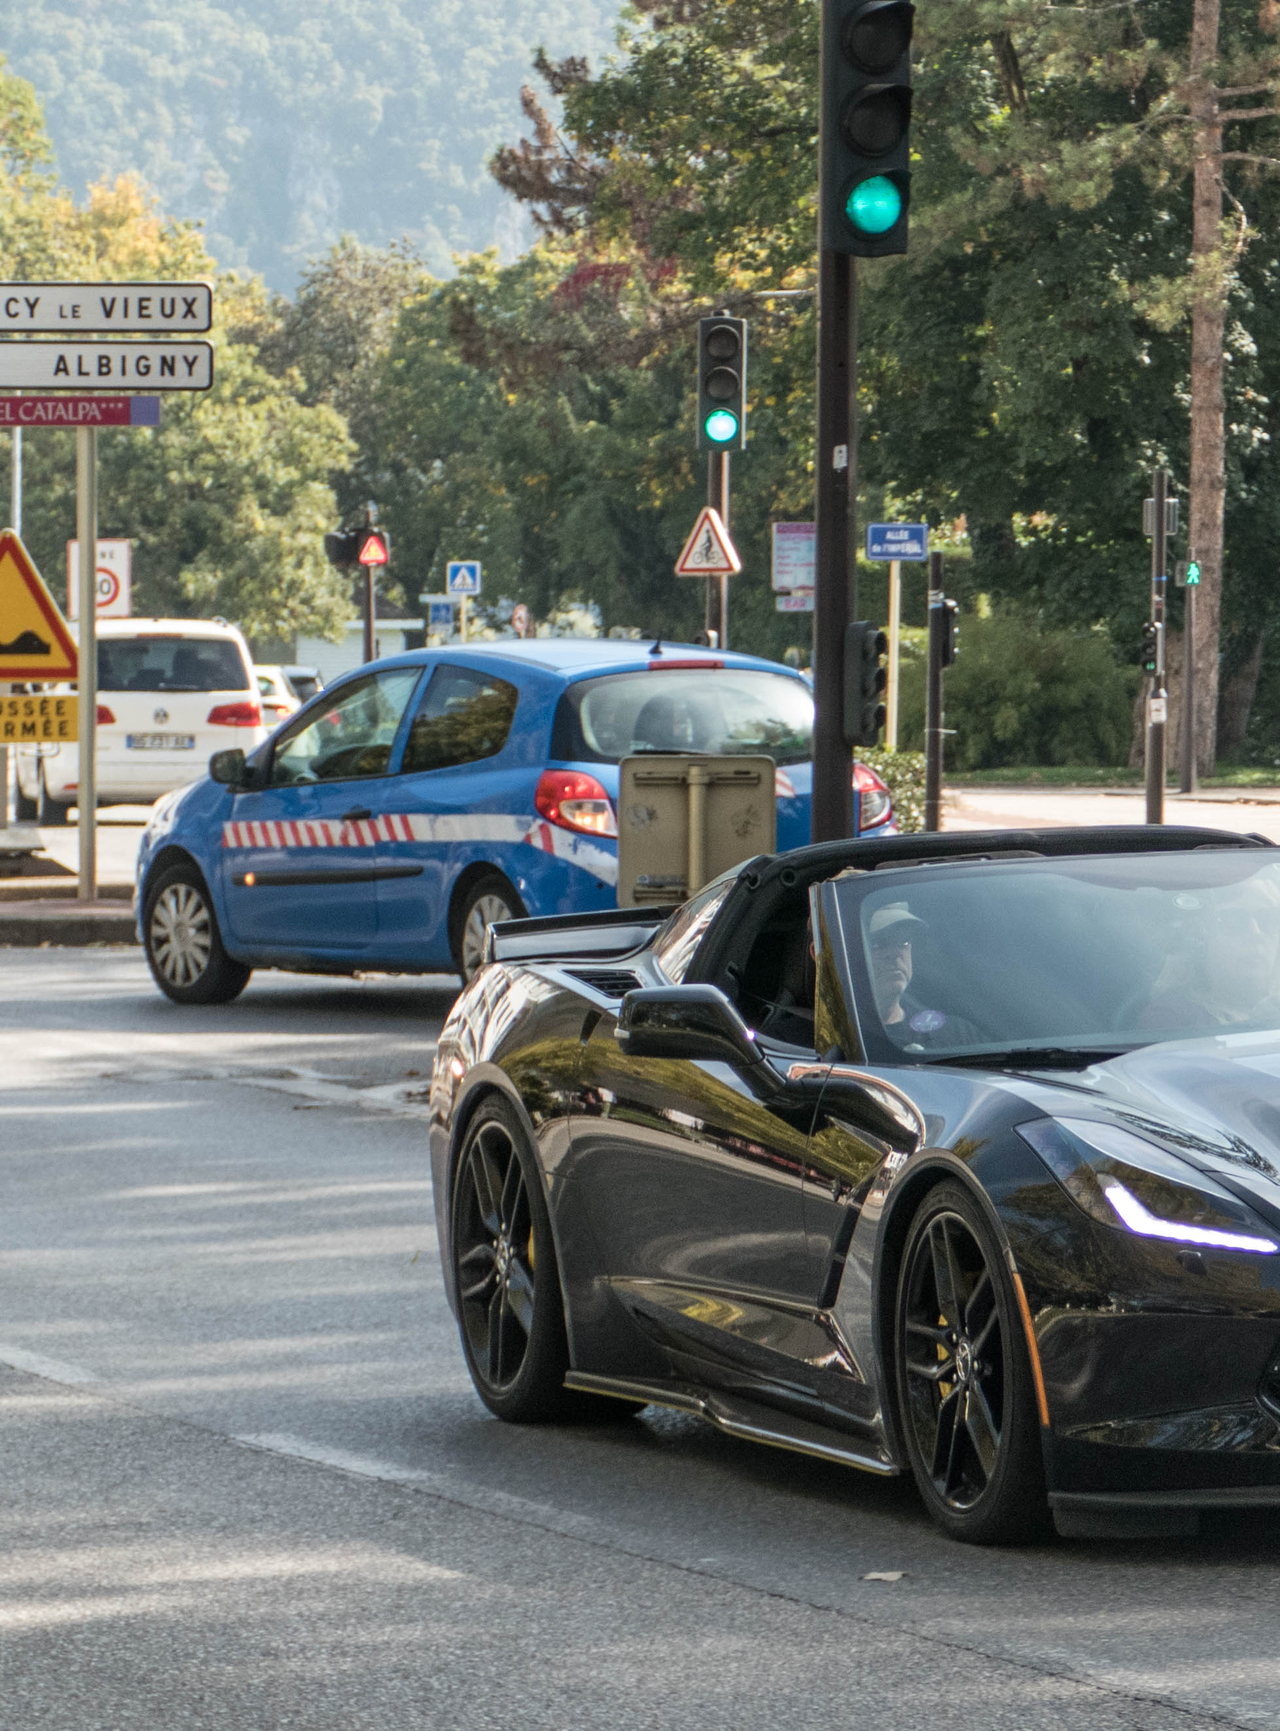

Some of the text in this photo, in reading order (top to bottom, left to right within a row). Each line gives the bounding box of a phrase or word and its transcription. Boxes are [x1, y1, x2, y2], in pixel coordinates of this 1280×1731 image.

[59, 304, 81, 319] LE
[100, 296, 198, 319] VIEUX
[53, 354, 199, 377] ALBIGNY
[99, 578, 112, 595] 0
